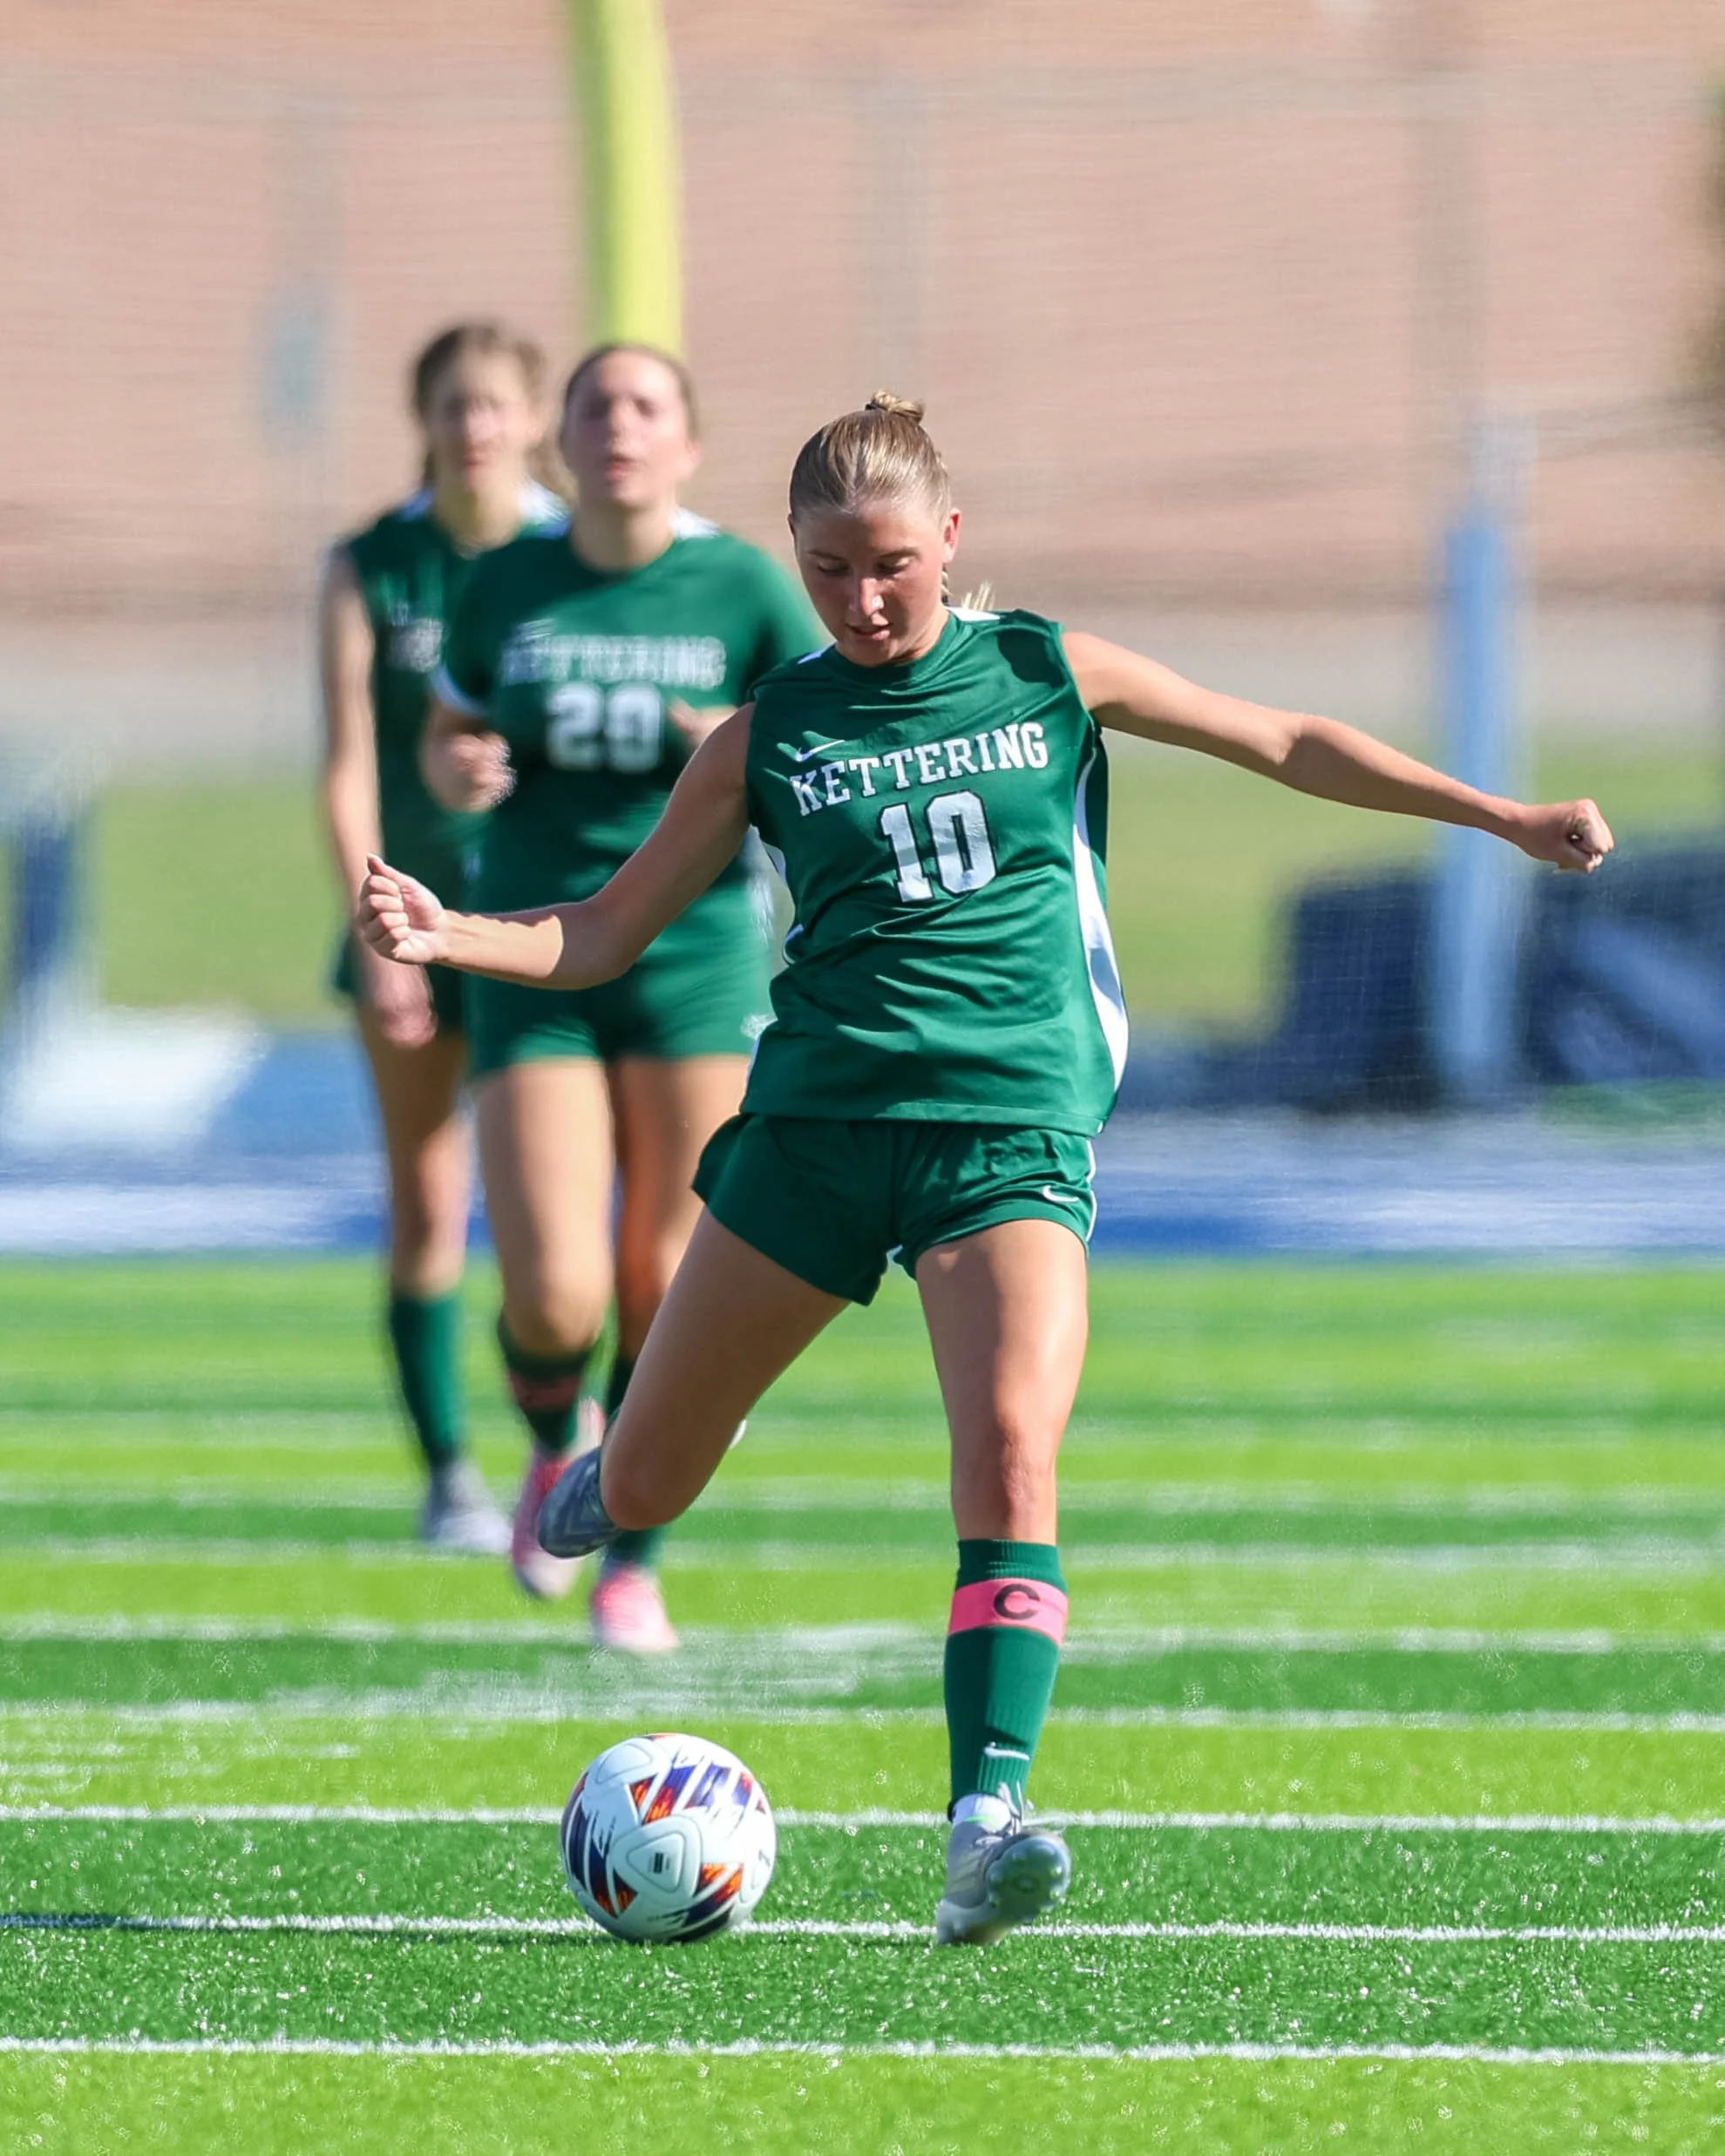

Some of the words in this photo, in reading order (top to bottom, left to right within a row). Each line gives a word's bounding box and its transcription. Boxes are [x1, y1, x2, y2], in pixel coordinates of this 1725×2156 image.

[547, 681, 663, 774] 20
[790, 722, 1049, 817] KETTERING
[880, 790, 996, 903] 10
[993, 1583, 1041, 1620] C
